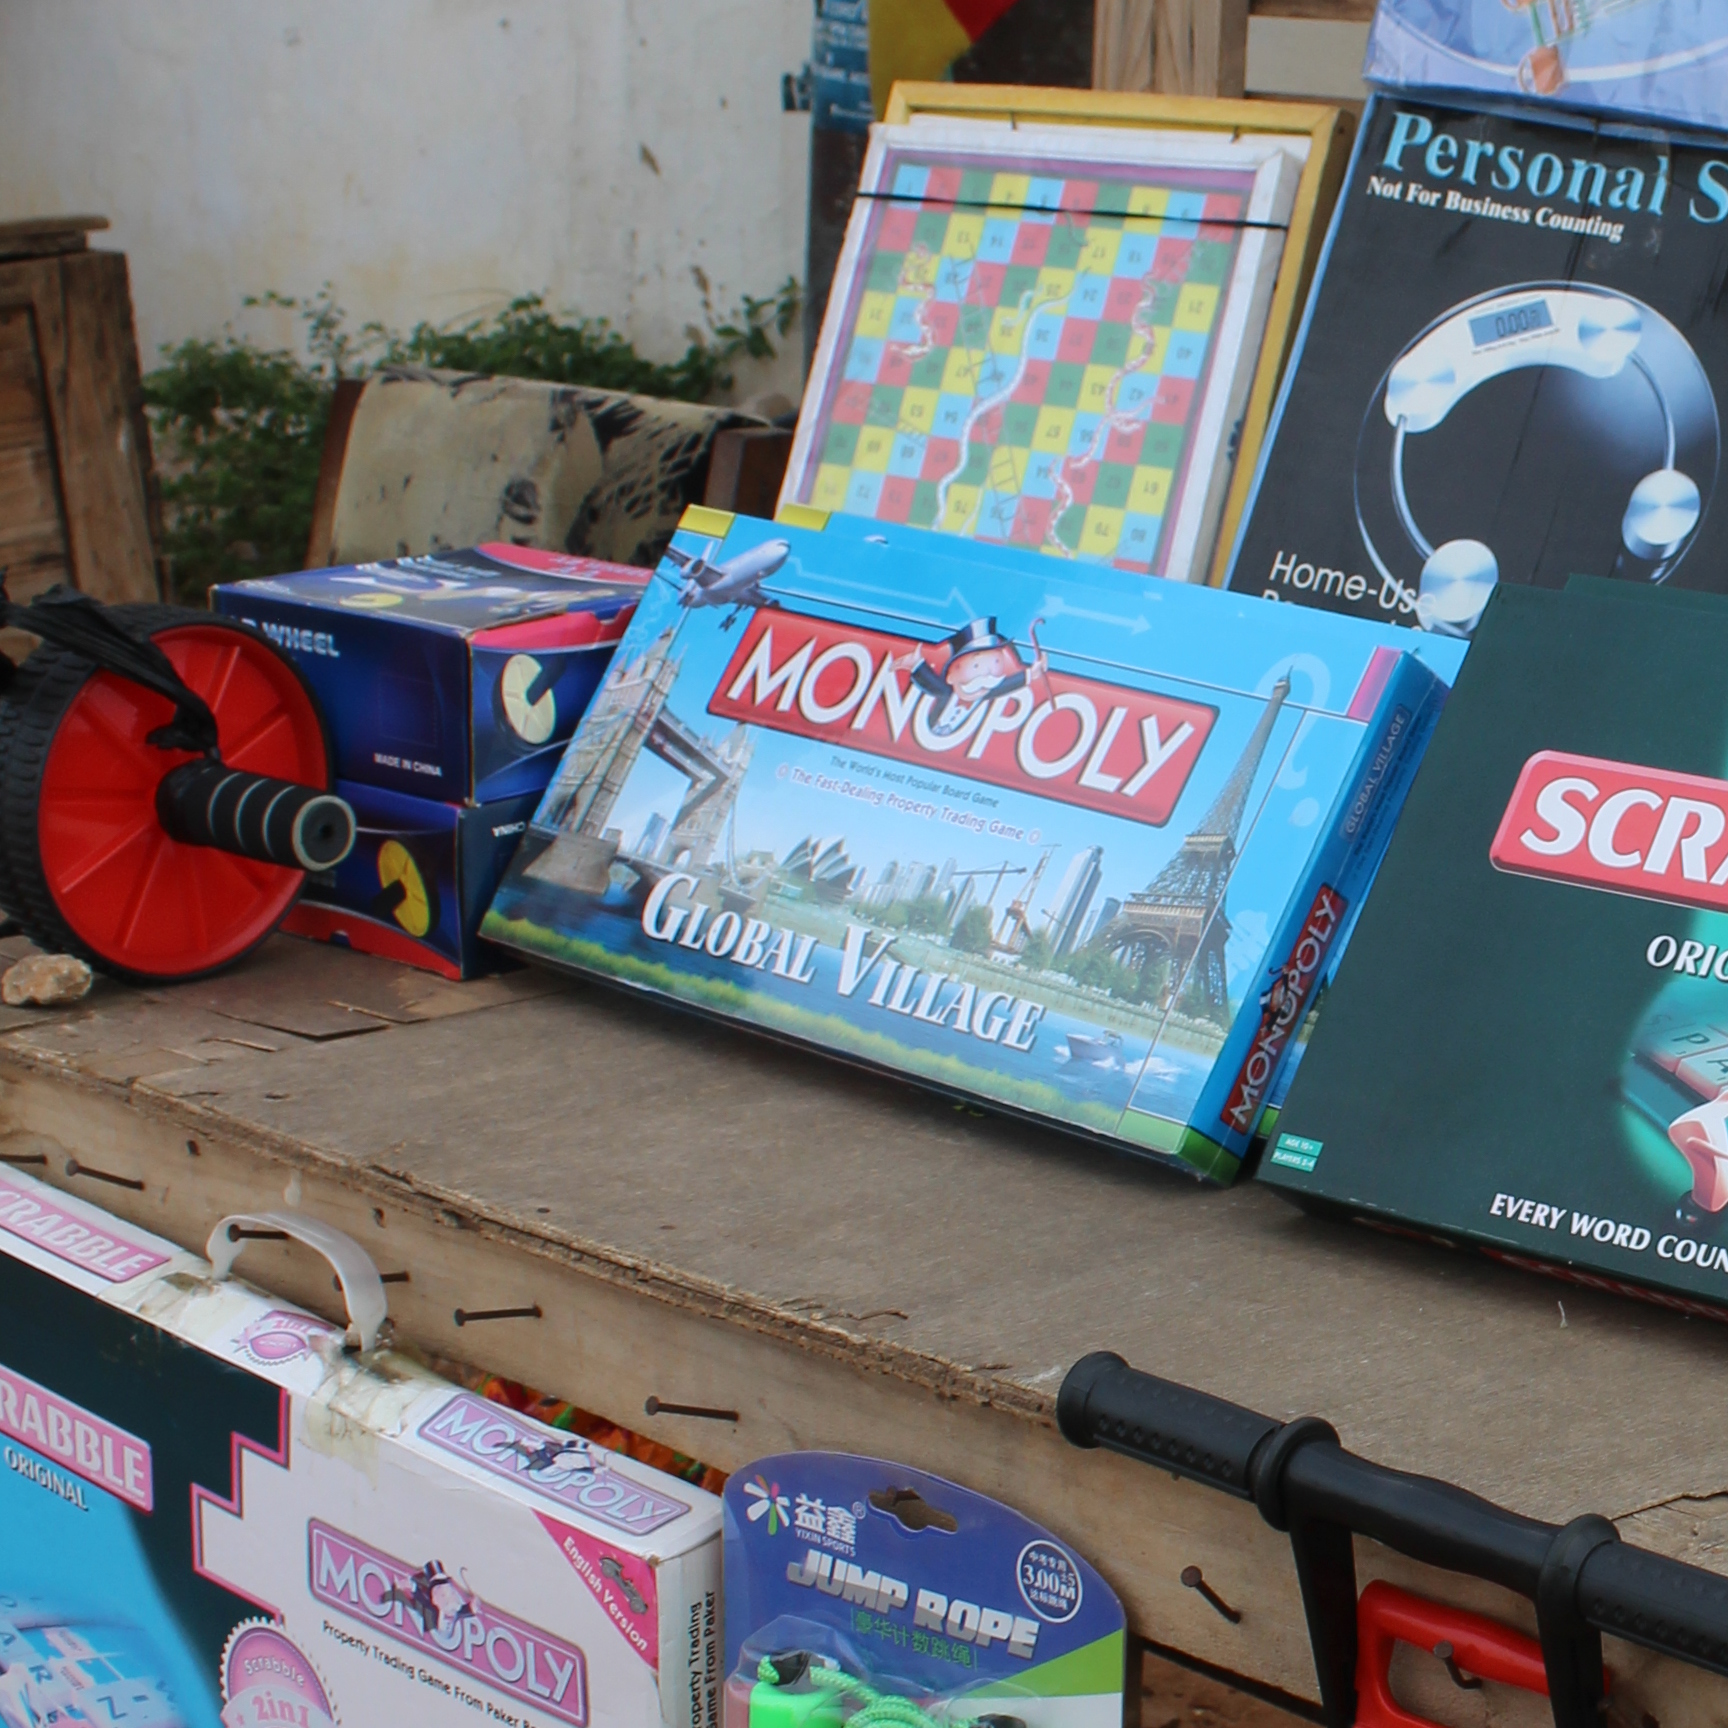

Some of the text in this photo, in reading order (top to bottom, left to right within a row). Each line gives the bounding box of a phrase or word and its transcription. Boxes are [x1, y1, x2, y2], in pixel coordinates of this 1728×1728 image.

[1383, 111, 1669, 215] Personal
[1366, 176, 1625, 242] Not For Business Counting
[262, 622, 340, 658] WHEEL
[727, 633, 1196, 800] MONOPOLY
[374, 753, 442, 777] MADE IN CHINA
[831, 755, 846, 769] The
[850, 760, 881, 779] World's
[906, 774, 940, 795] Popular
[943, 784, 970, 801] Board
[972, 792, 1000, 808] Game
[790, 767, 1025, 842] The Fast-Dealing Property Trading Game
[642, 870, 1046, 1055] GLOBAL VILLAGE
[1229, 893, 1339, 1126] MONOPOLY
[1490, 1193, 1567, 1230] EVERY
[1569, 1212, 1651, 1252] WORD
[4, 1445, 90, 1512] ORIGINAL
[434, 1404, 671, 1522] MONOPOLY
[795, 1493, 857, 1545] 益鑫
[795, 1529, 856, 1558] YIXIN SPORTS
[319, 1540, 575, 1703] MONOPOLY
[563, 1535, 649, 1653] English Version
[703, 1591, 716, 1645] Paker
[787, 1549, 1041, 1661] JUMP ROPE
[688, 1602, 702, 1670] Trading
[704, 1647, 718, 1690] From
[244, 1657, 305, 1687] Scrabble
[321, 1619, 371, 1656] Property
[372, 1644, 415, 1679] Trading
[417, 1667, 452, 1696] Game
[454, 1684, 484, 1710] From
[485, 1701, 520, 1728] Paker
